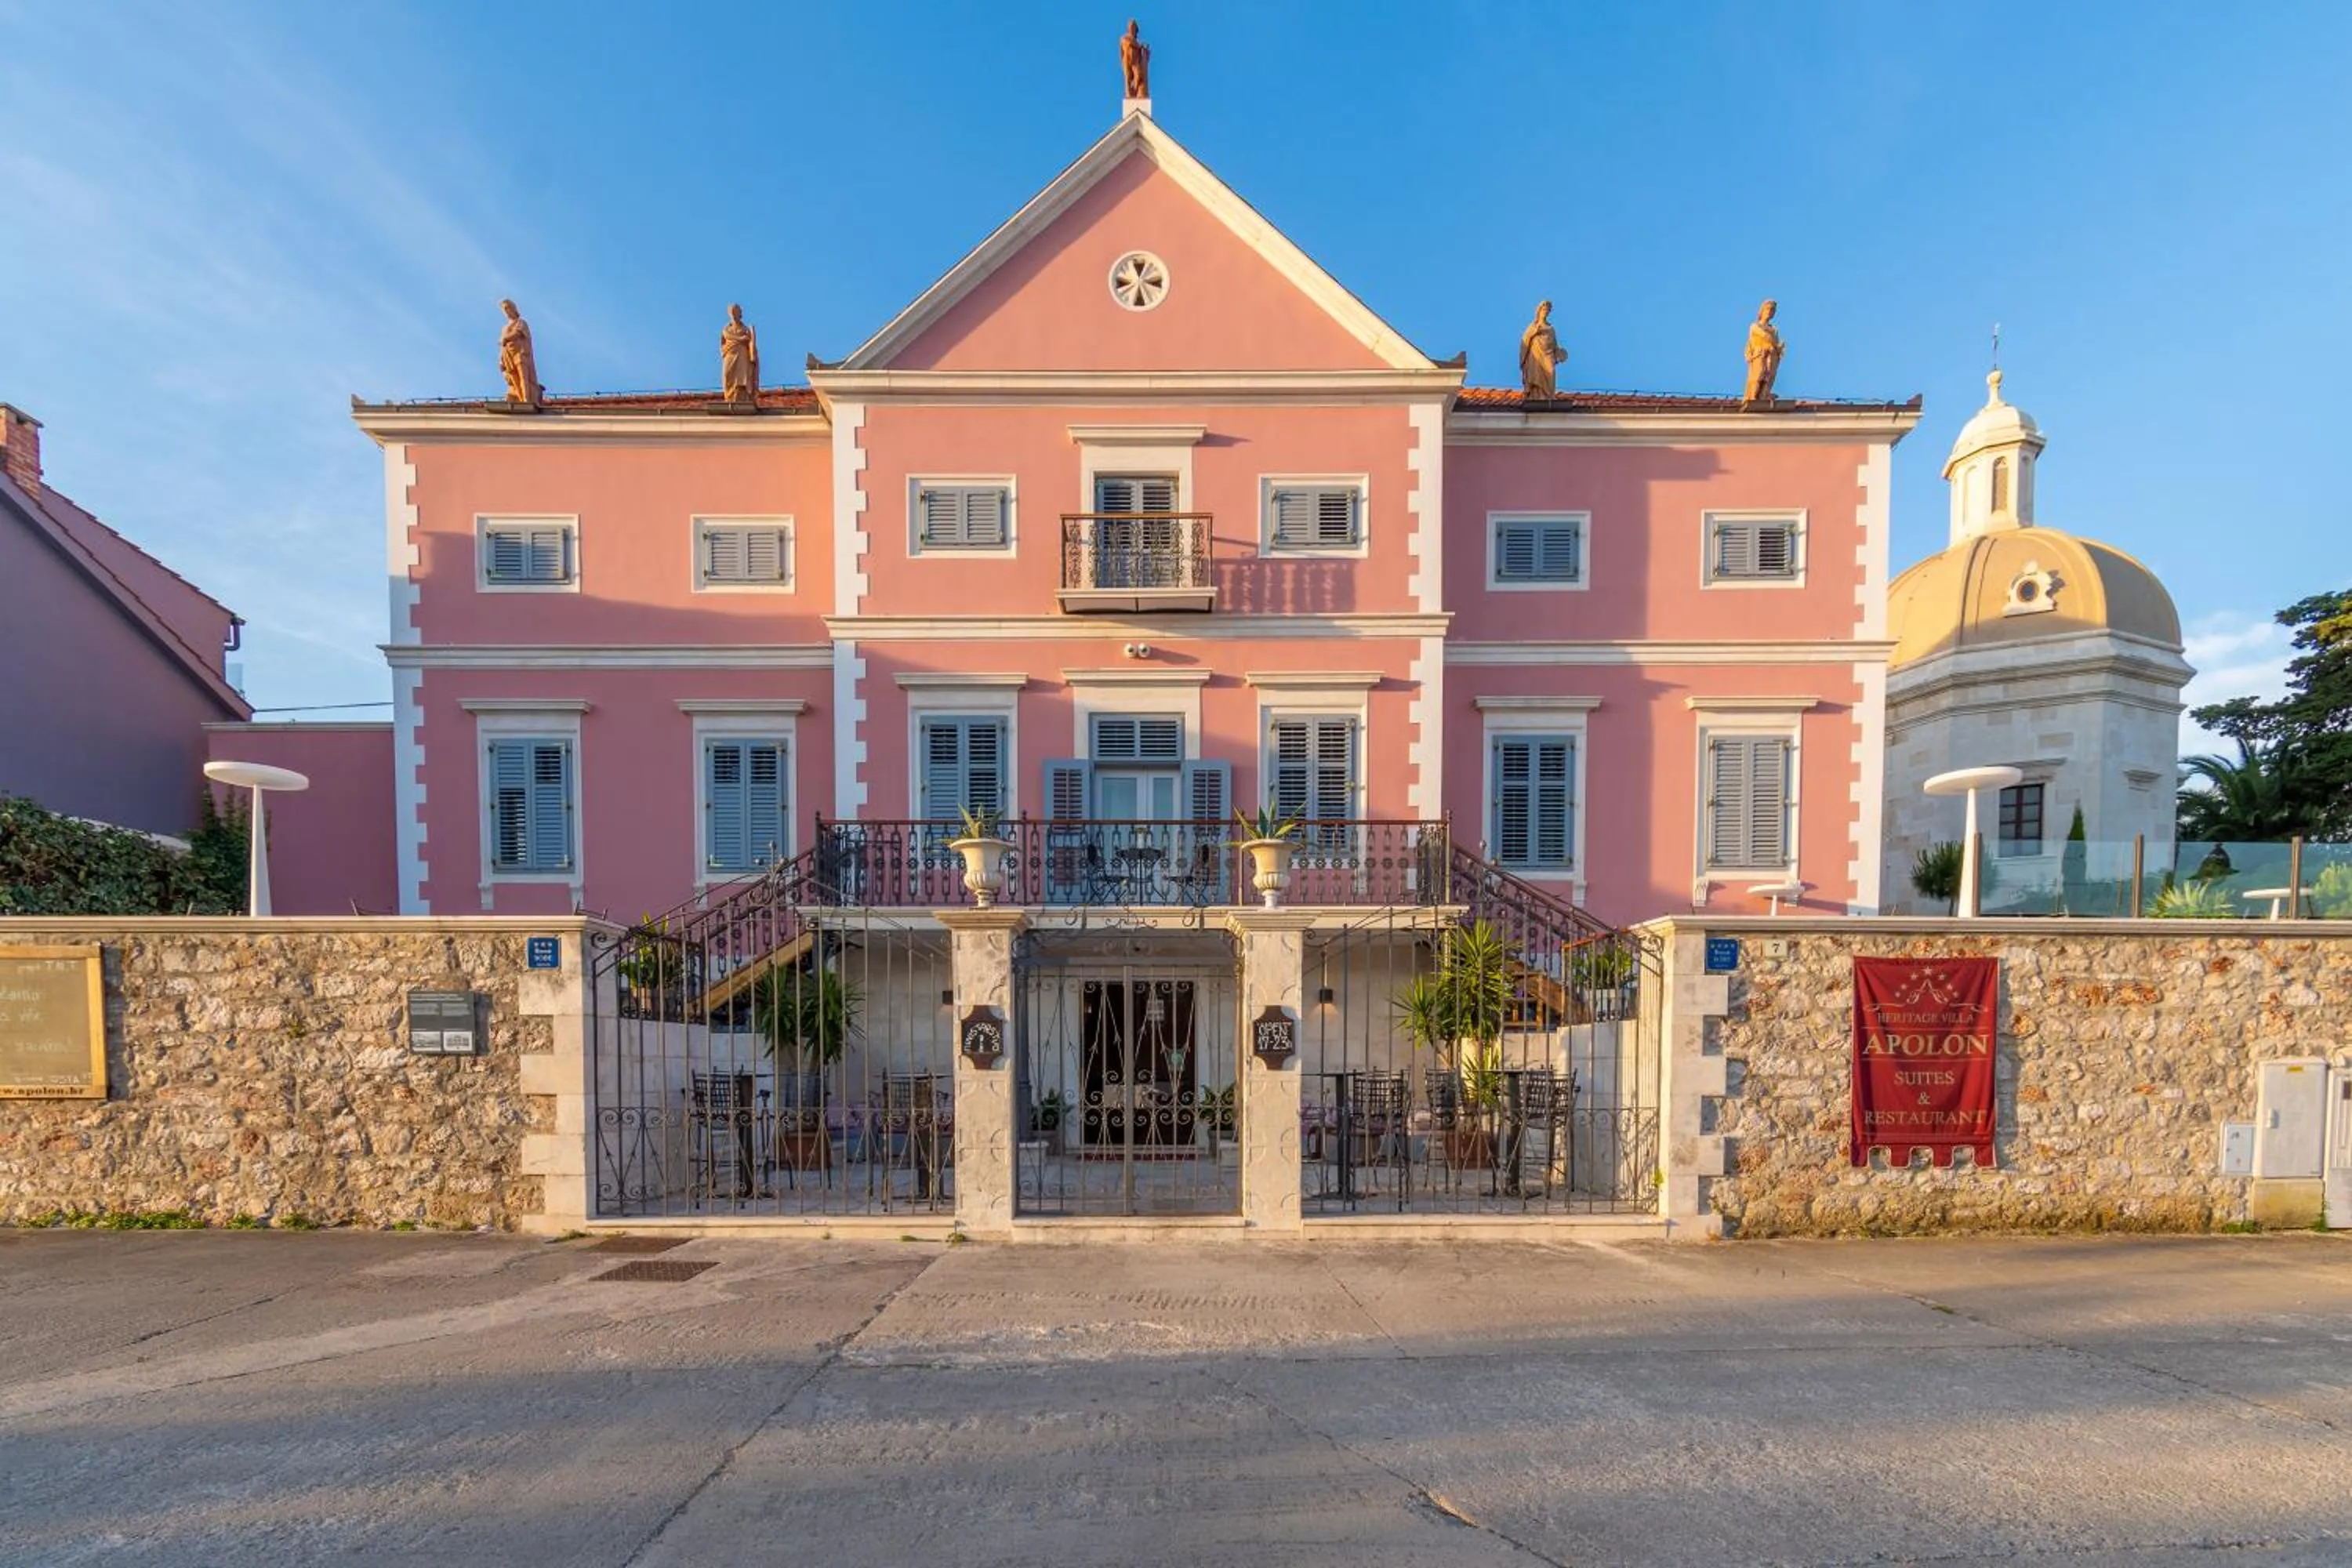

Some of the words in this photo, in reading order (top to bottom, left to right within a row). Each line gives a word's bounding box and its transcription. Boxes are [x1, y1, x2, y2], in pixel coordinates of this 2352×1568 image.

[1771, 942, 1780, 954] 7
[1878, 1012, 1938, 1024] HERITAGE
[1942, 1012, 1974, 1024] VILLA
[1258, 1022, 1288, 1036] OPEN
[1863, 1033, 1989, 1055] APOLON
[1893, 1070, 1955, 1085] SUITES
[1918, 1091, 1931, 1105] &
[1864, 1110, 1988, 1126] RESTAURANT
